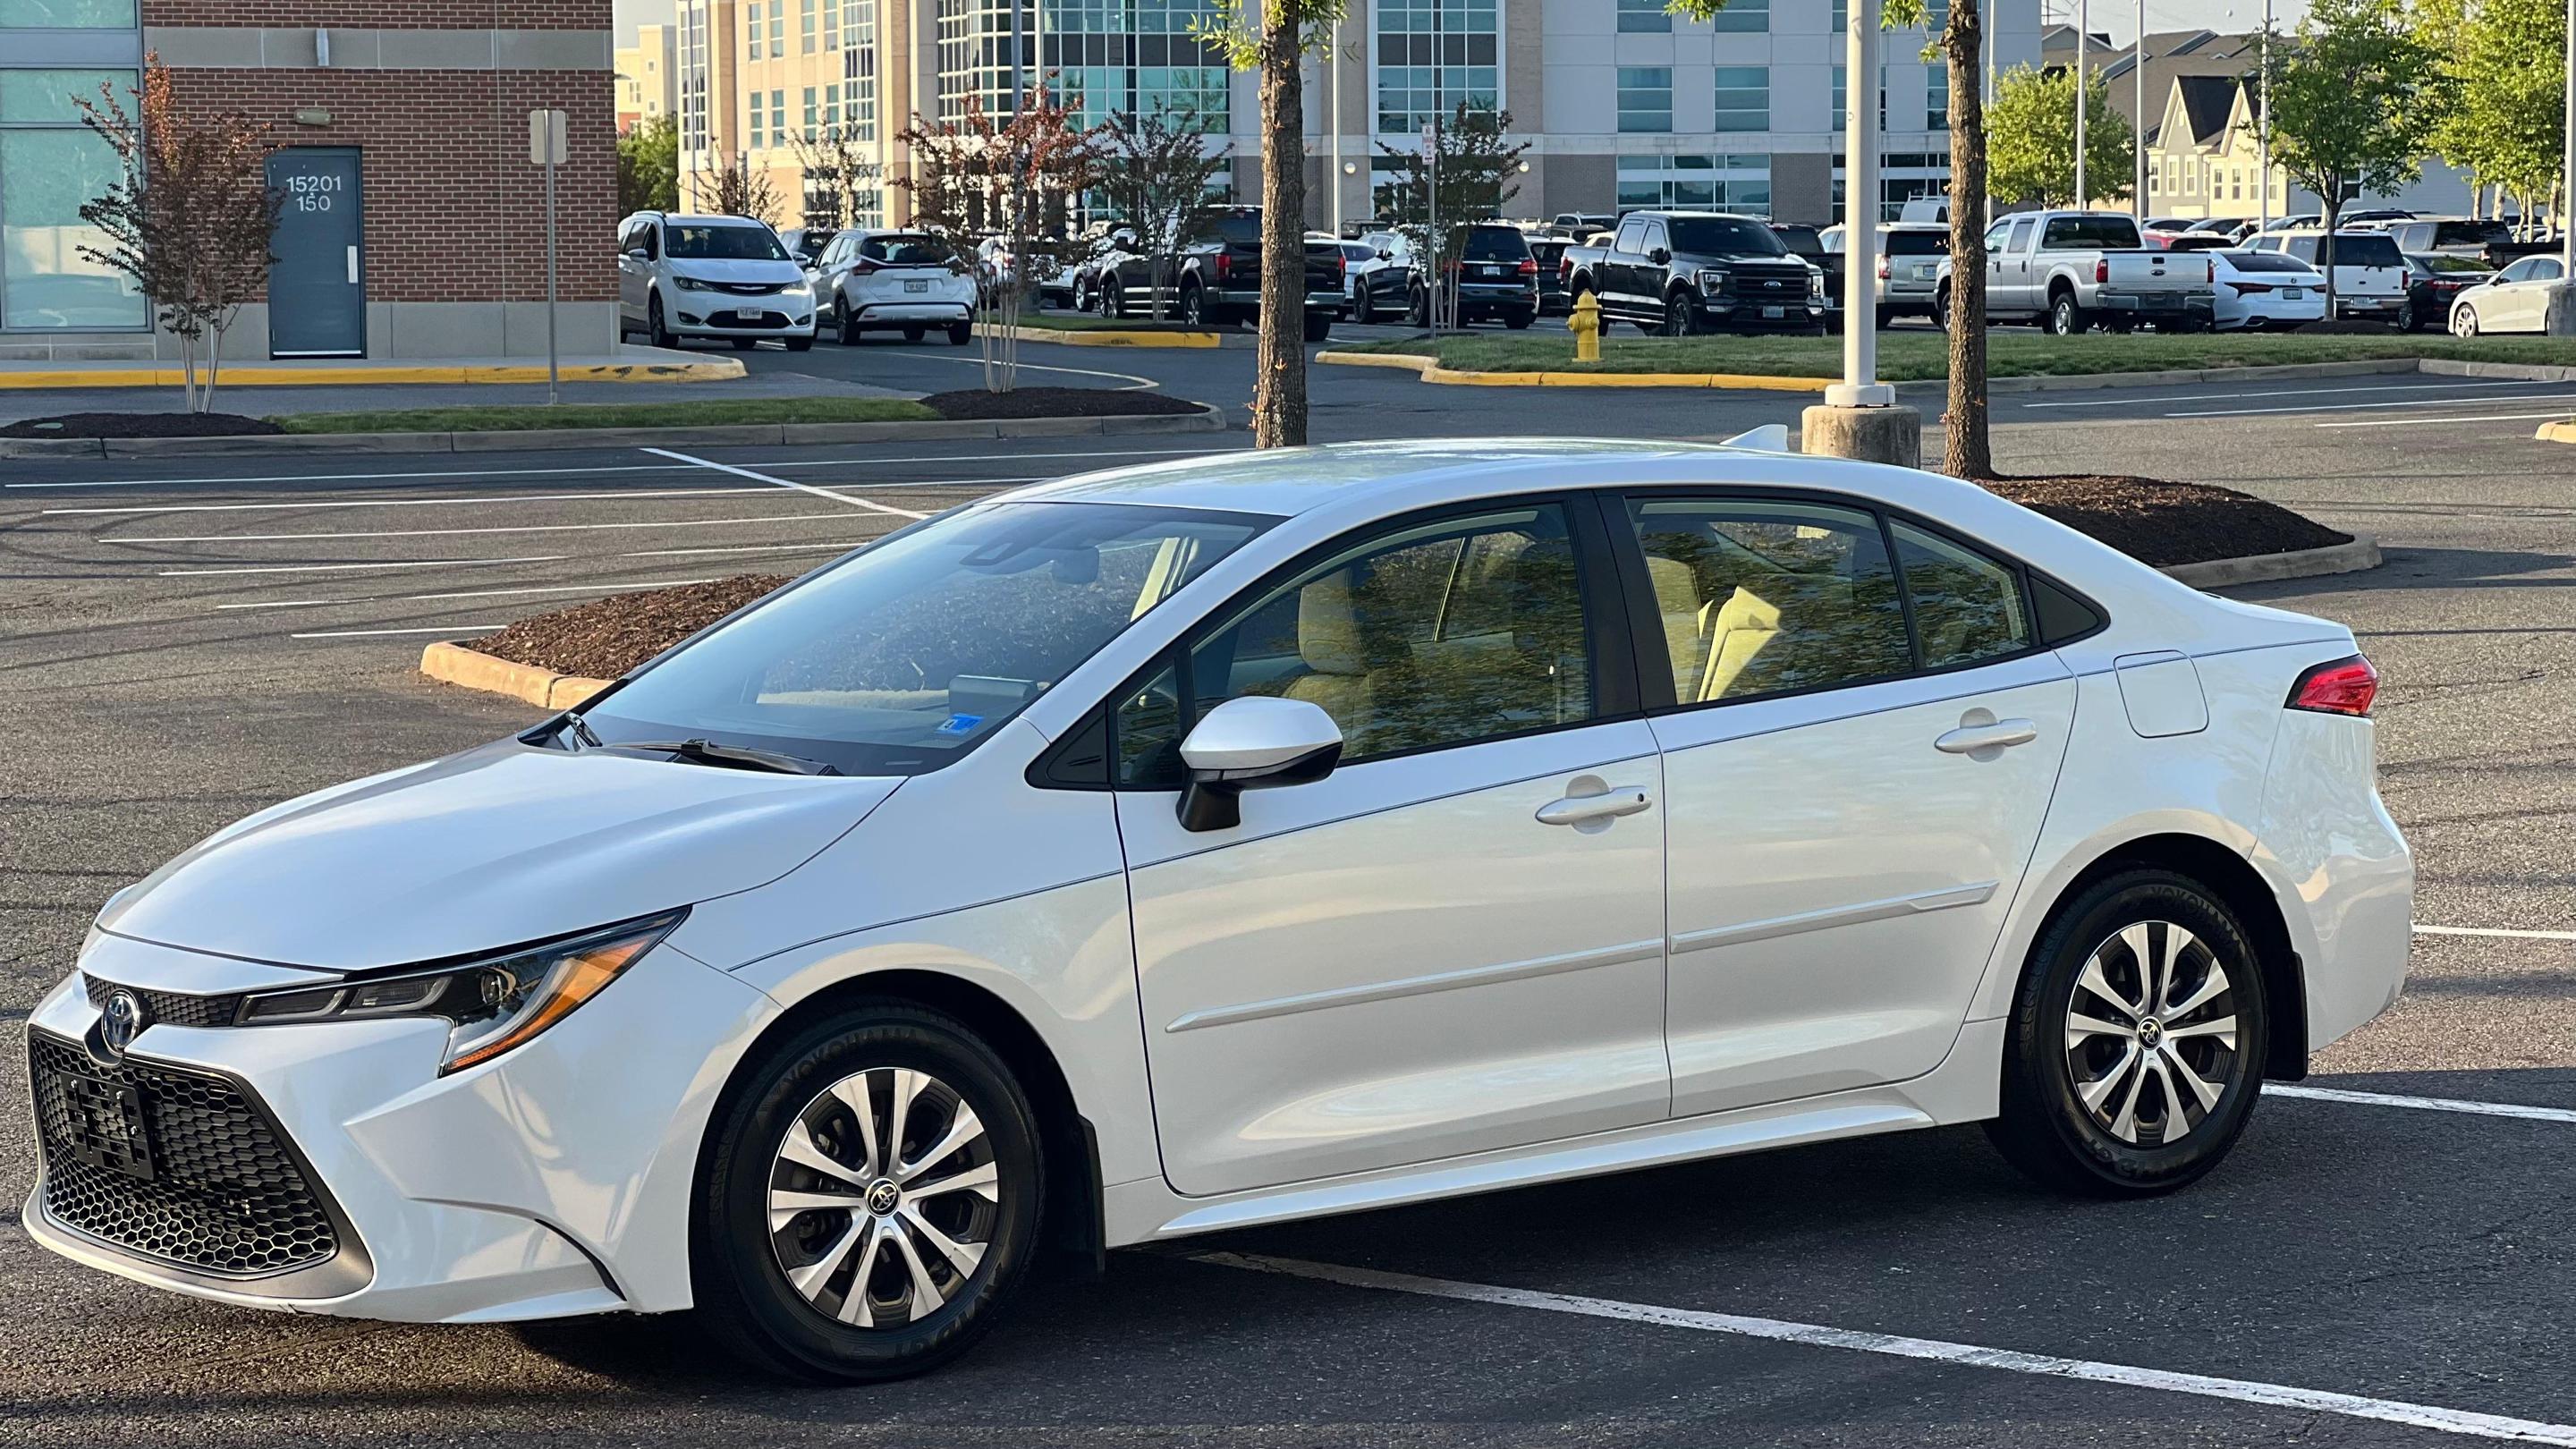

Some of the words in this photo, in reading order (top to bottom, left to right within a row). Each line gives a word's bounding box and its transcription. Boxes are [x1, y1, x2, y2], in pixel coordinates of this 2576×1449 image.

[286, 175, 341, 192] 15201
[296, 195, 331, 212] 150
[781, 1027, 918, 1086] YOKOHAMA
